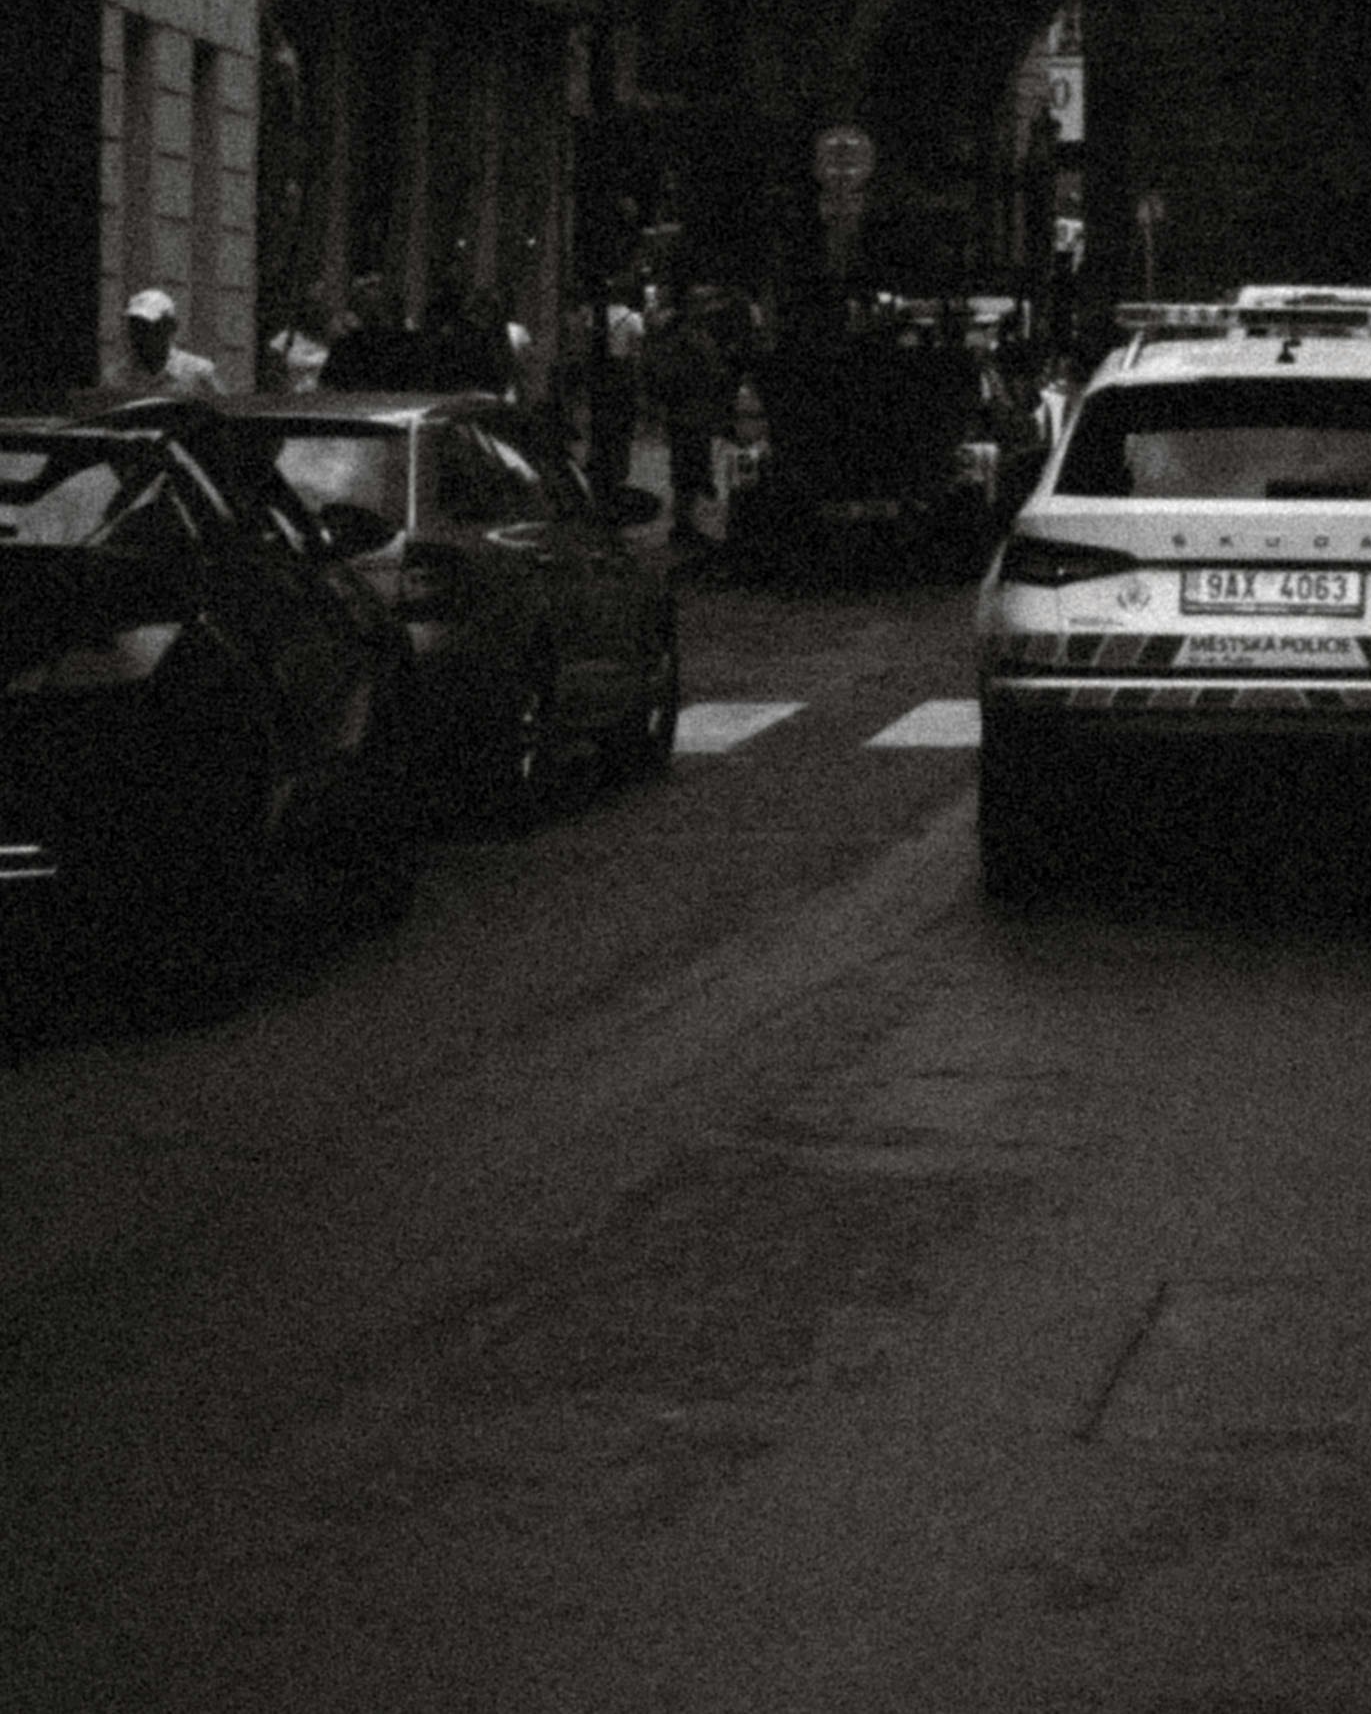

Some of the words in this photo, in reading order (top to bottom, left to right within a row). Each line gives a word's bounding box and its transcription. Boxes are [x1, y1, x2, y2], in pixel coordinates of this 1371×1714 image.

[1207, 574, 1257, 600] 9AX
[1280, 576, 1348, 602] 4063
[1281, 637, 1352, 654] POLICIE
